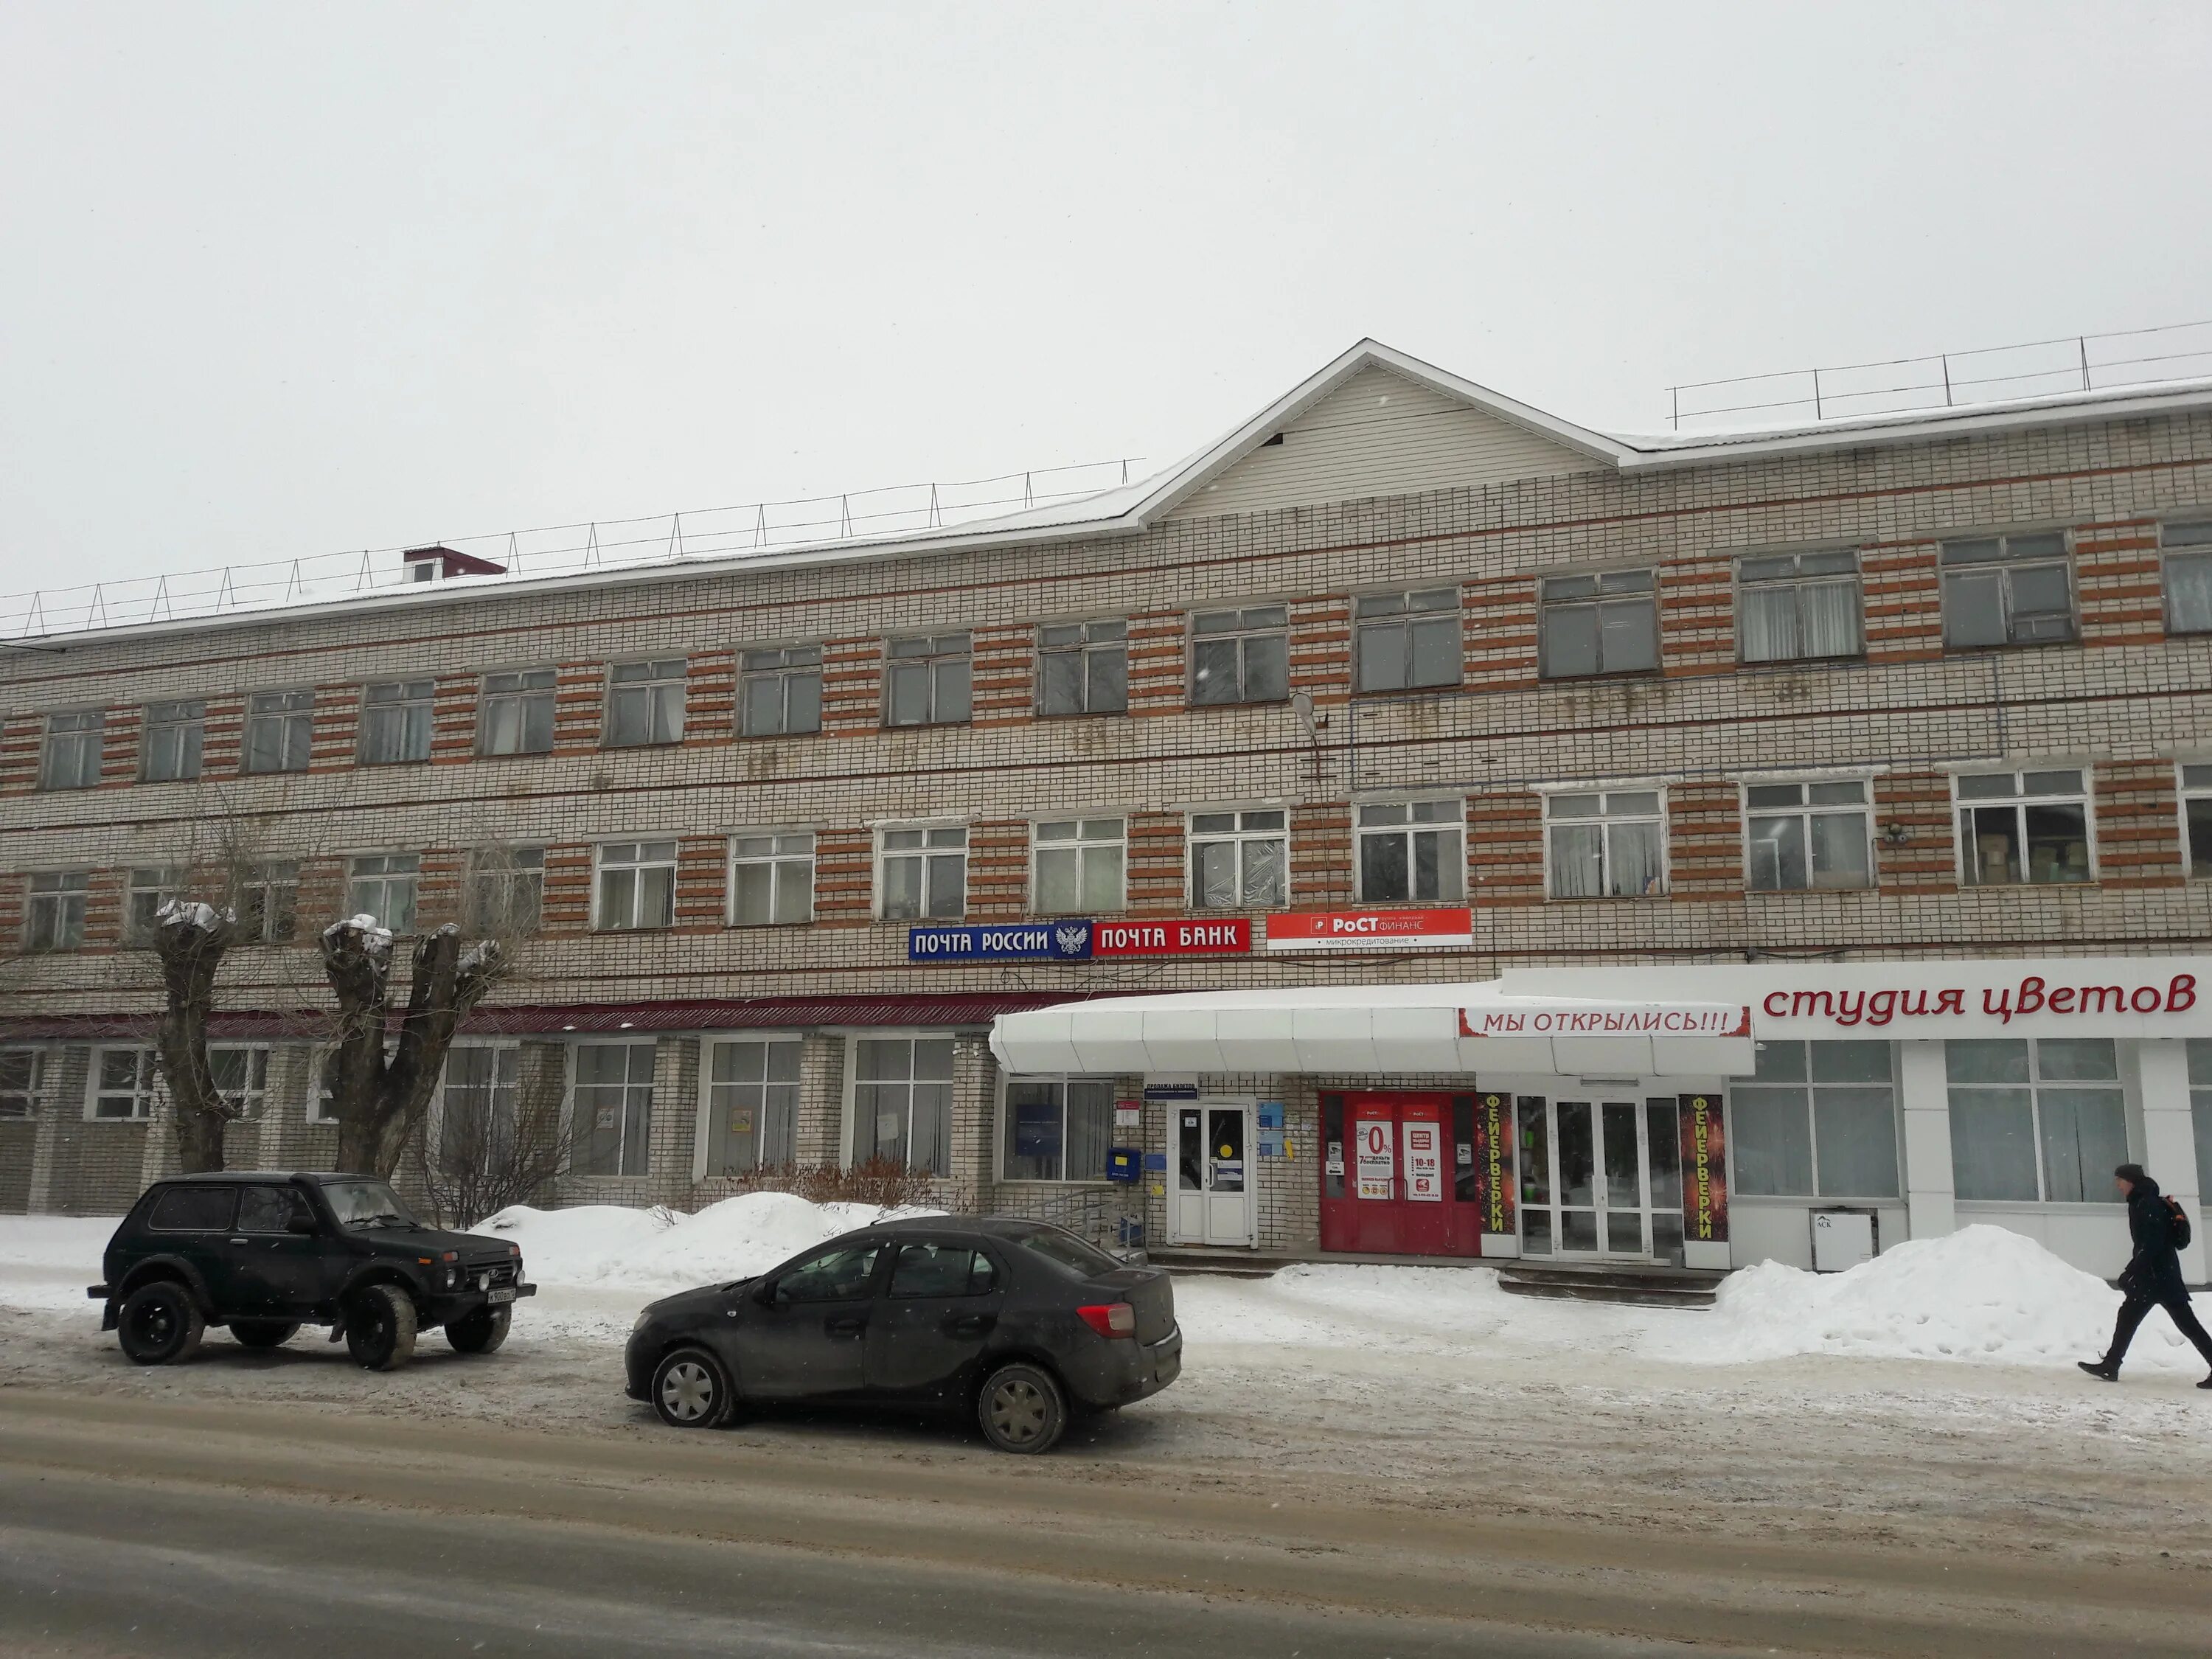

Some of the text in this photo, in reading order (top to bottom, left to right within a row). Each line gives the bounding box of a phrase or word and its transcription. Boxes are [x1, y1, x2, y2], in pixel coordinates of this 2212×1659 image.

[1102, 925, 1237, 948] ПОЧТА БАНК
[1379, 921, 1424, 931] ФИНАНС
[915, 931, 1048, 953] ПОЧТА РОССИИ
[1326, 937, 1409, 947] микрокредитование
[1763, 988, 1965, 1026] студия
[1484, 1012, 1728, 1032] МЫ ОТКРЫЛИСЬ!!!
